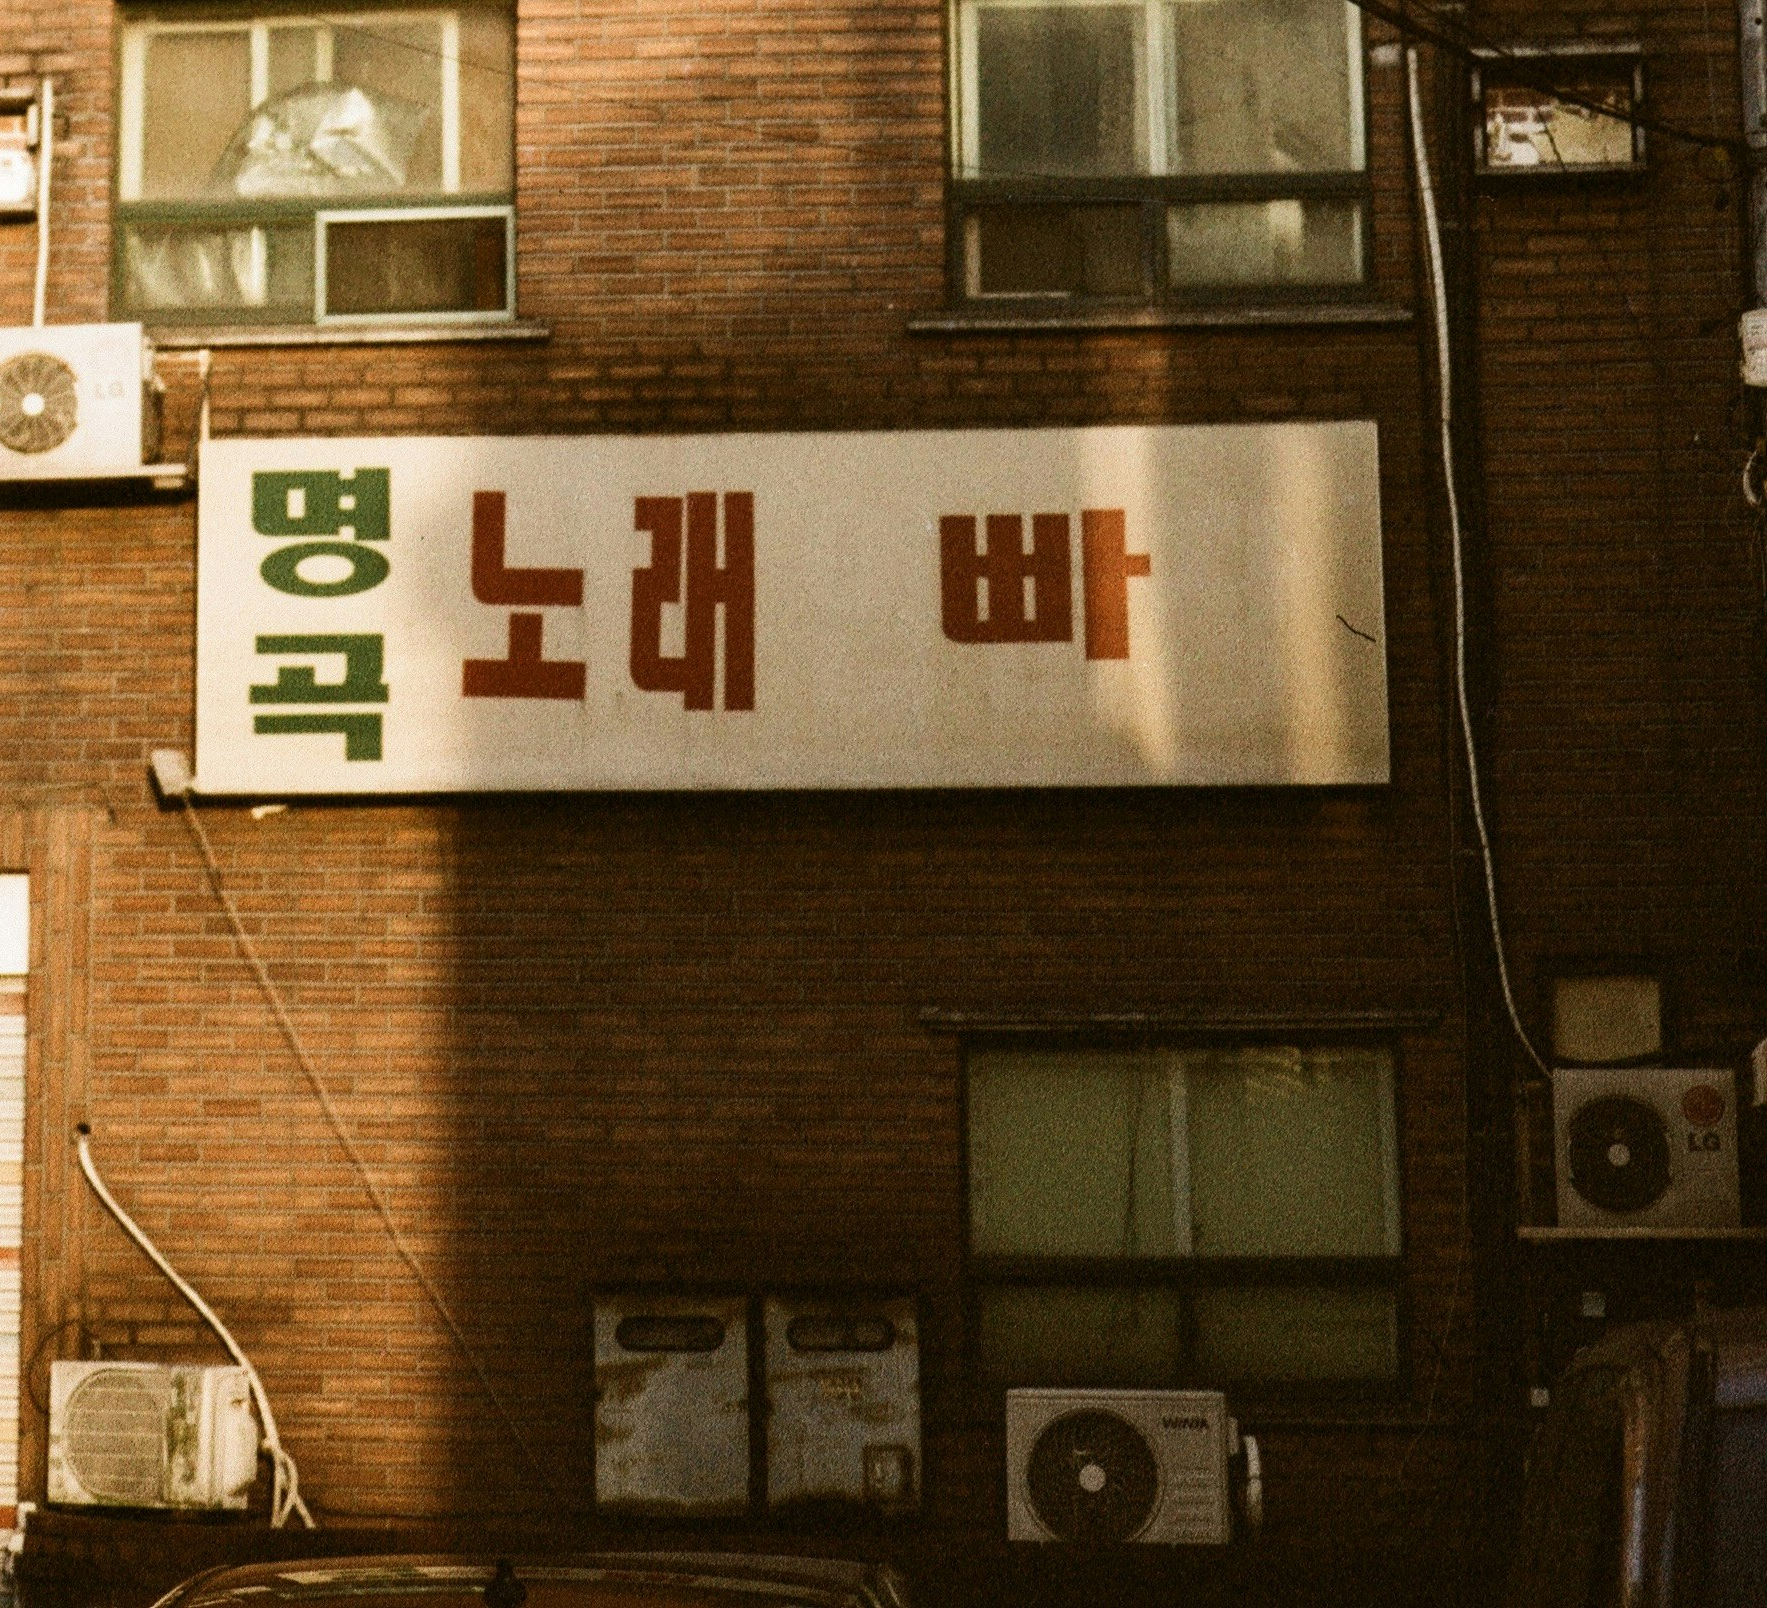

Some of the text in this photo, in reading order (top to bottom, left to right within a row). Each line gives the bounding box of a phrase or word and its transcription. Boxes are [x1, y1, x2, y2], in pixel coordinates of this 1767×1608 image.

[93, 381, 125, 399] LG
[248, 466, 391, 762] 명곡
[463, 491, 1151, 711] 노래 빠
[1687, 1132, 1721, 1152] LG
